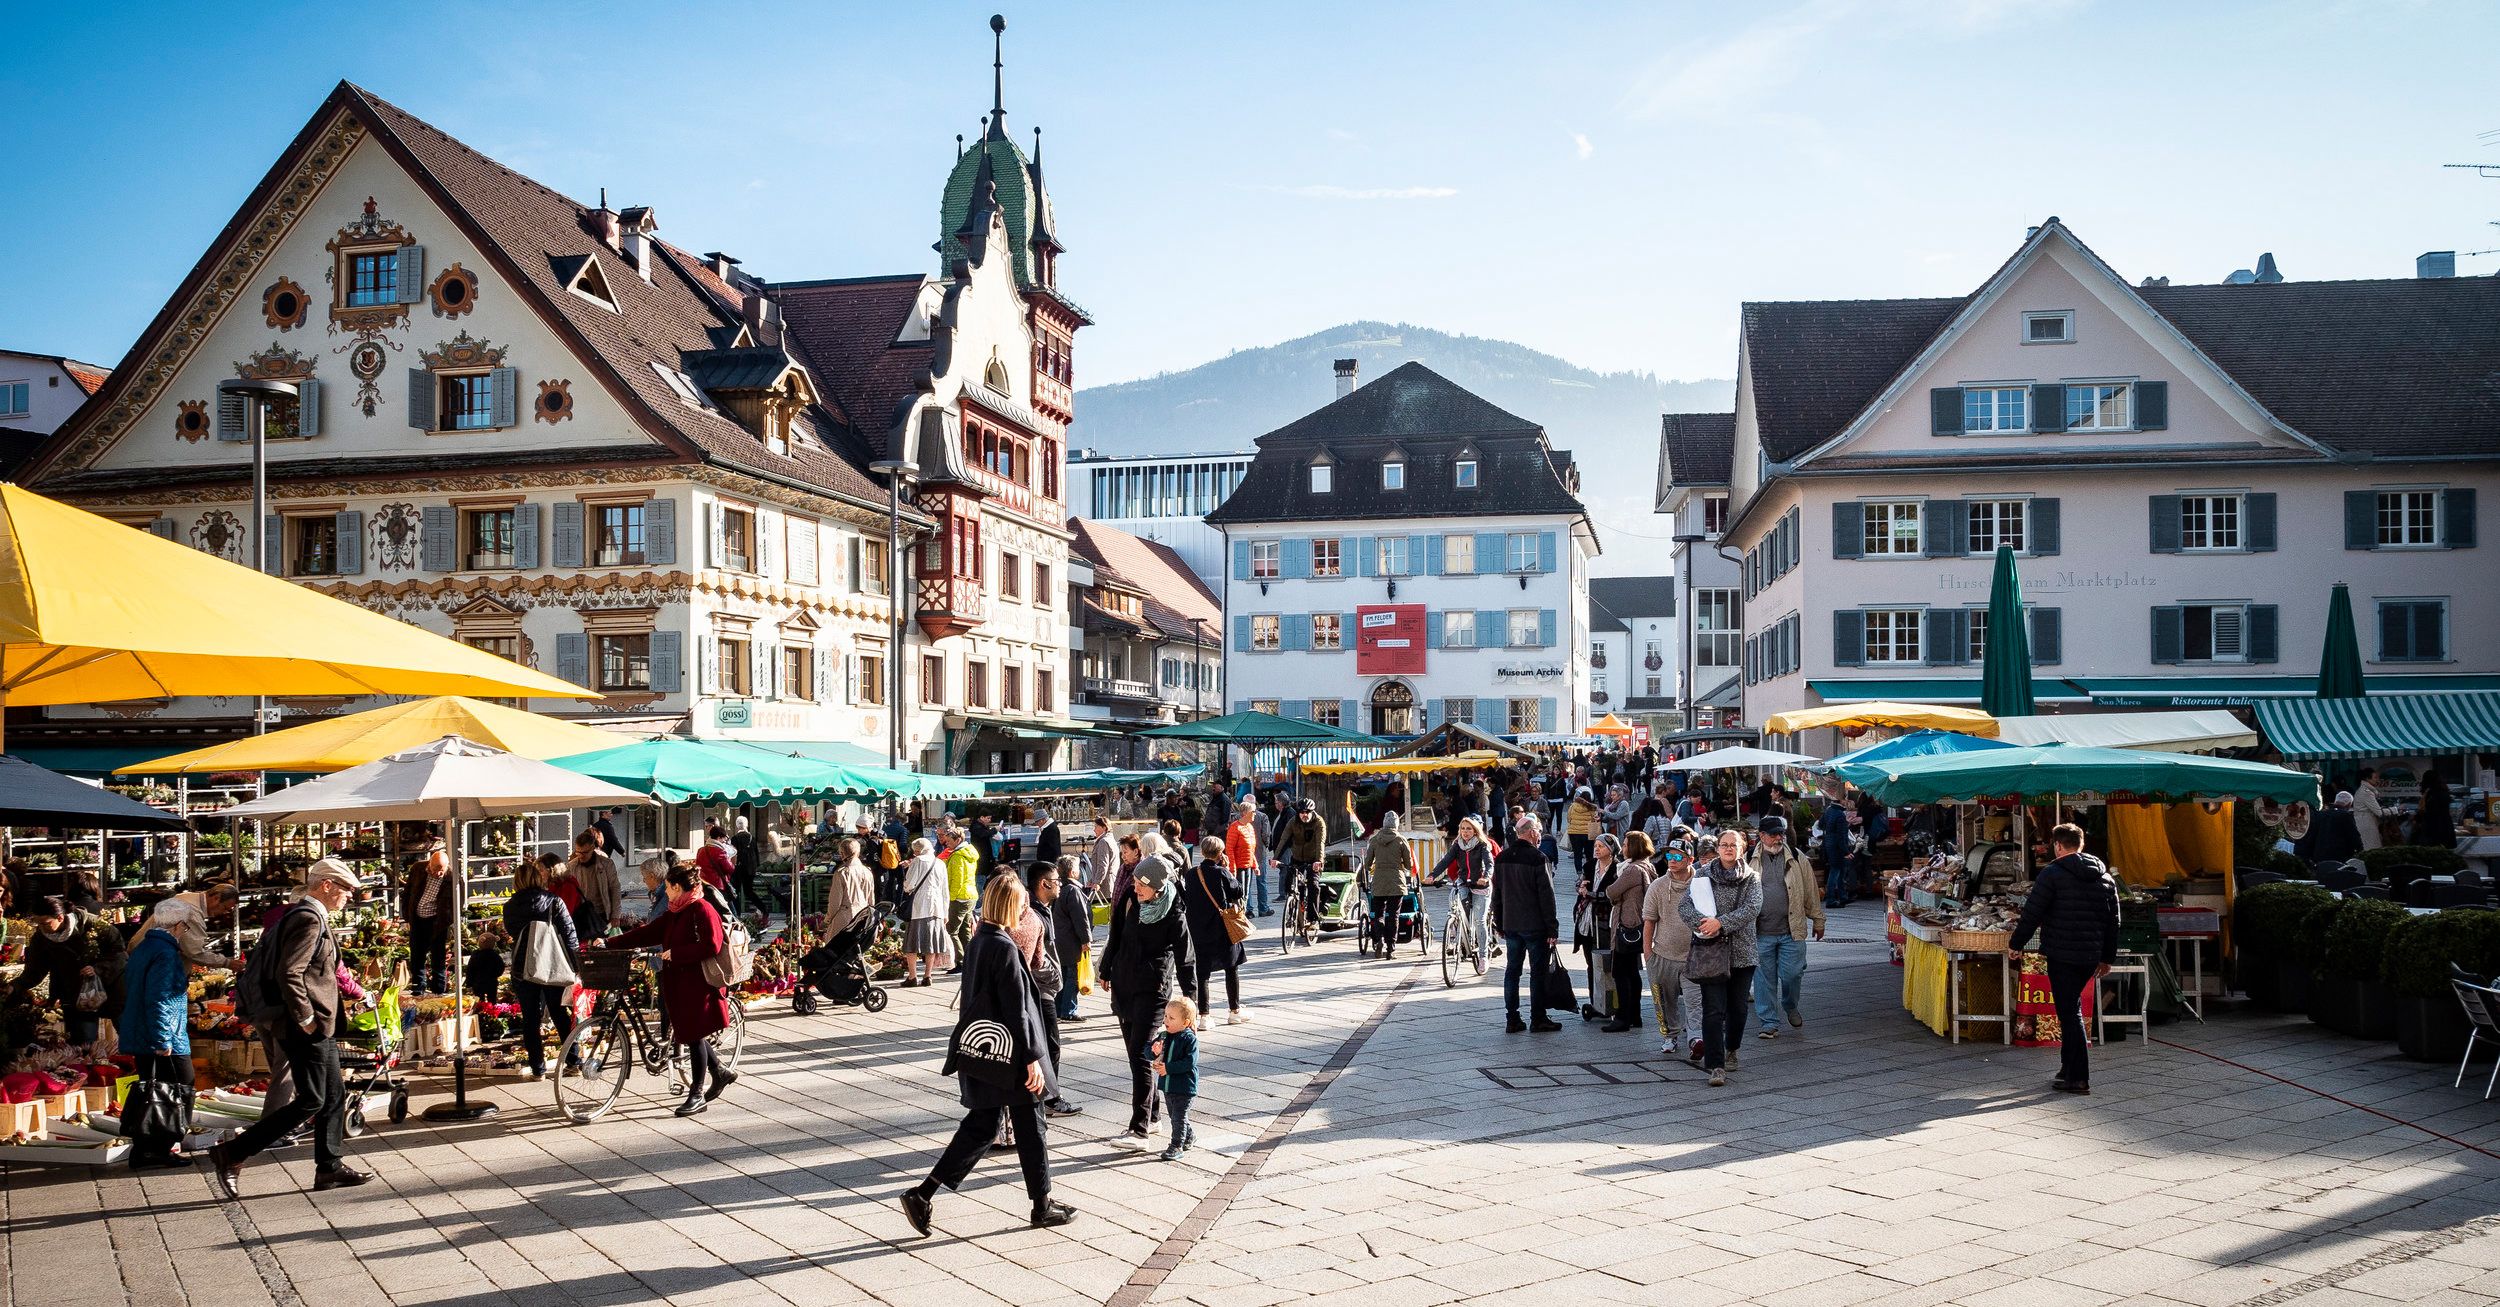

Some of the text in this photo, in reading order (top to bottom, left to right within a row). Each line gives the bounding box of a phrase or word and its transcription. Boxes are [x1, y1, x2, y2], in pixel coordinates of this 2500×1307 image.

[1938, 571, 2157, 589] Hirsc am Marktplatz
[1497, 668, 1564, 677] Museum Archiv
[2171, 696, 2266, 706] Ristorante Italia
[722, 709, 745, 721] gössl
